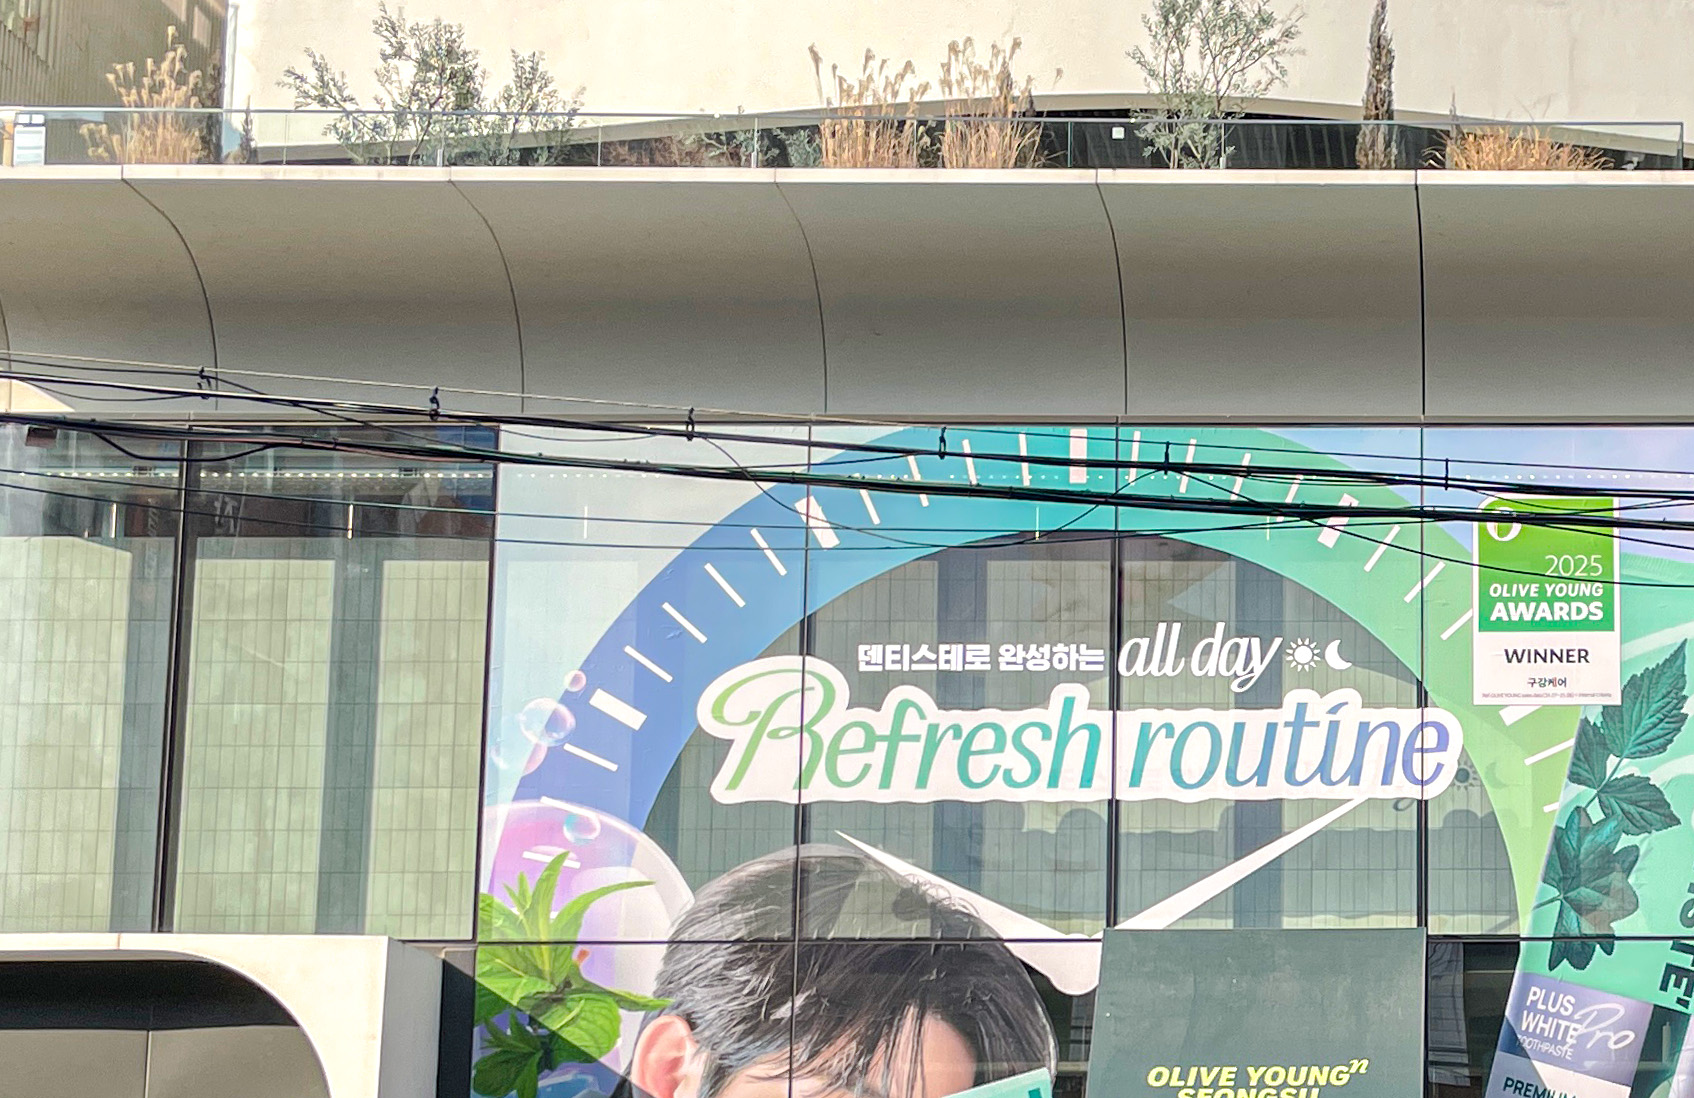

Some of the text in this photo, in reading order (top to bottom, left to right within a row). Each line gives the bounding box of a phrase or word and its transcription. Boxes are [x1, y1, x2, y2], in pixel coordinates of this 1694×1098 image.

[1544, 554, 1603, 576] 2025
[1489, 583, 1604, 598] OLIVE YOUNG
[1489, 601, 1604, 622] AWARDS
[857, 643, 1105, 673] 덴티스테로 완성하는
[1117, 621, 1284, 694] all day
[1503, 647, 1591, 664] WINNER
[1527, 675, 1568, 688] 구강케어
[708, 667, 1450, 792] Refresh routine
[1520, 1010, 1582, 1045] WHITE
[1526, 986, 1636, 1053] PLUS Pro
[1146, 1065, 1238, 1088] OLIVE
